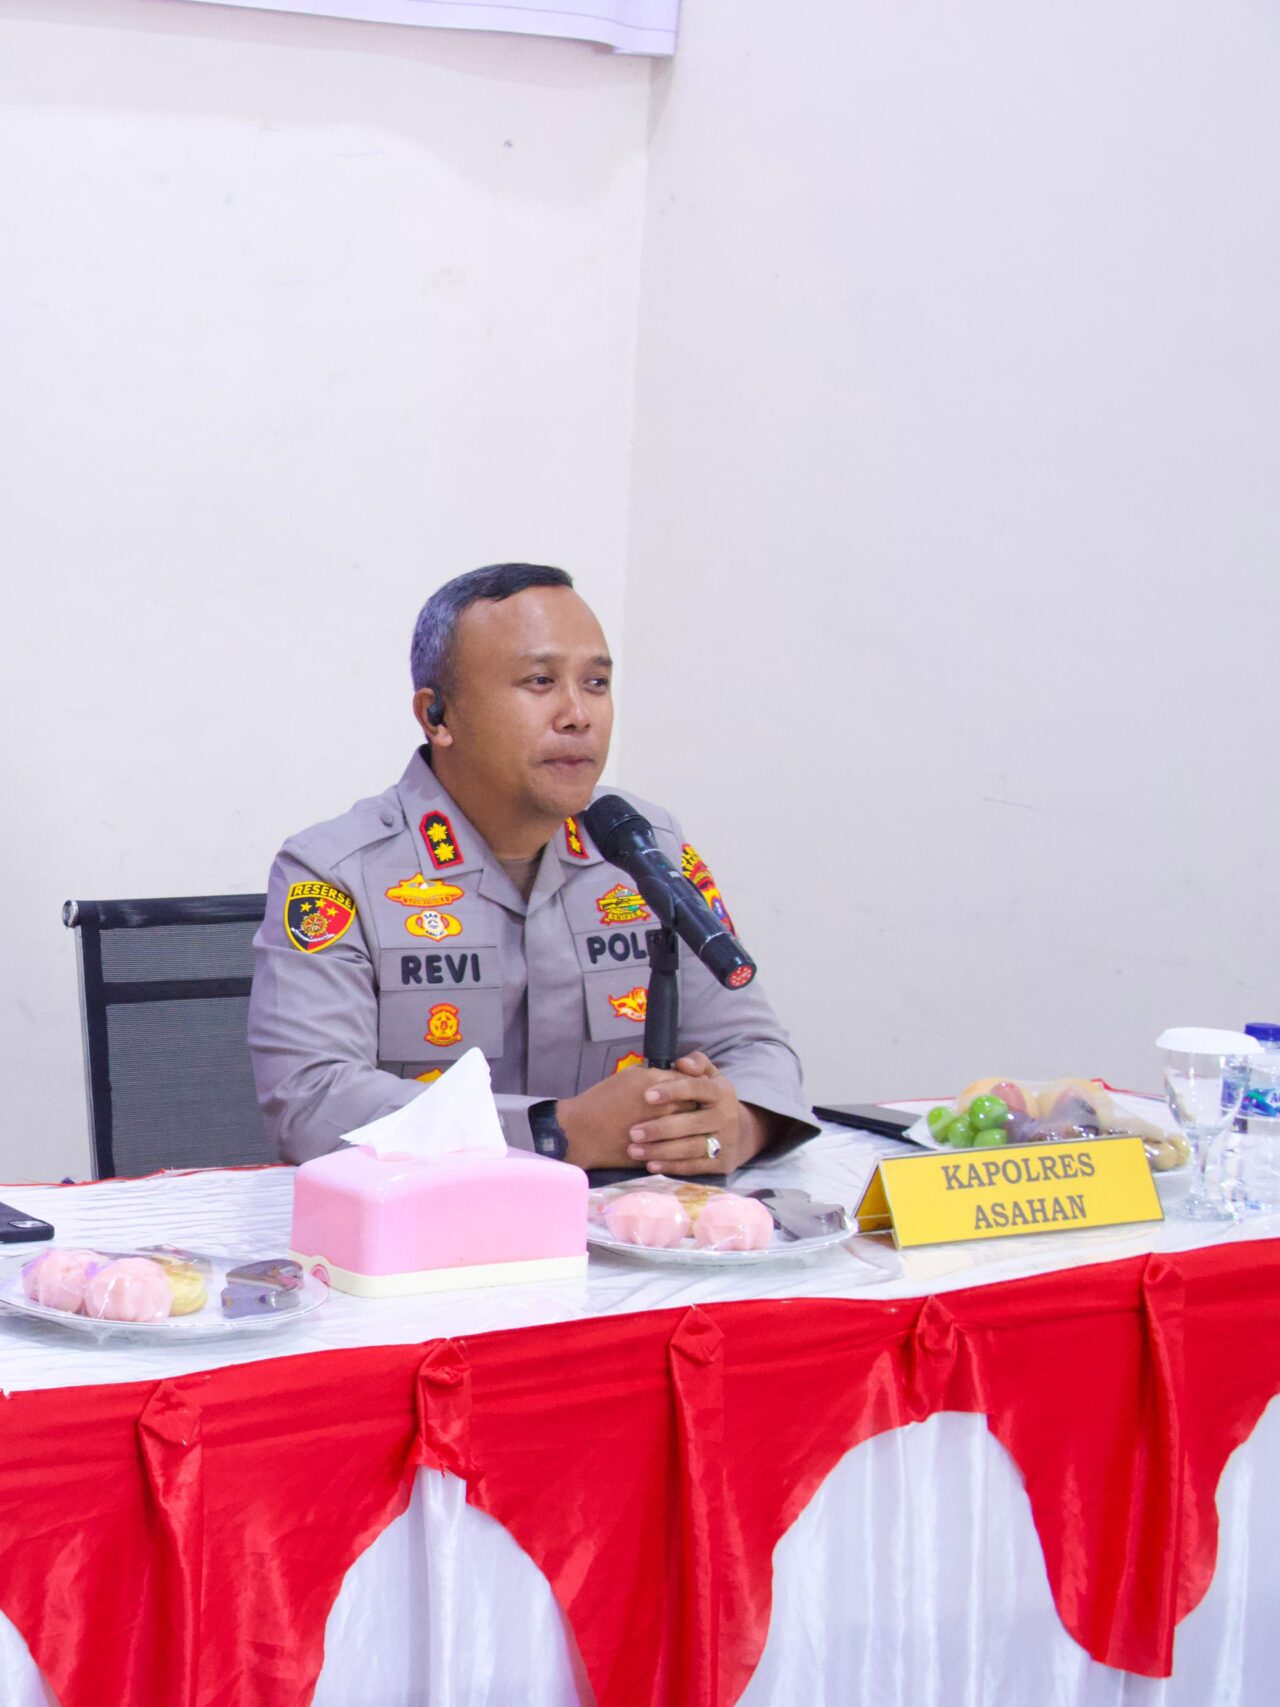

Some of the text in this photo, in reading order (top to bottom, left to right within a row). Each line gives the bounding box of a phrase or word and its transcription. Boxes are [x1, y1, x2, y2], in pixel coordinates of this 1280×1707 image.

[293, 884, 354, 908] RESERSE
[586, 931, 648, 965] POL
[401, 953, 481, 985] REVI
[940, 1152, 1096, 1191] KAPOLRES
[973, 1194, 1088, 1230] ASAHAN
